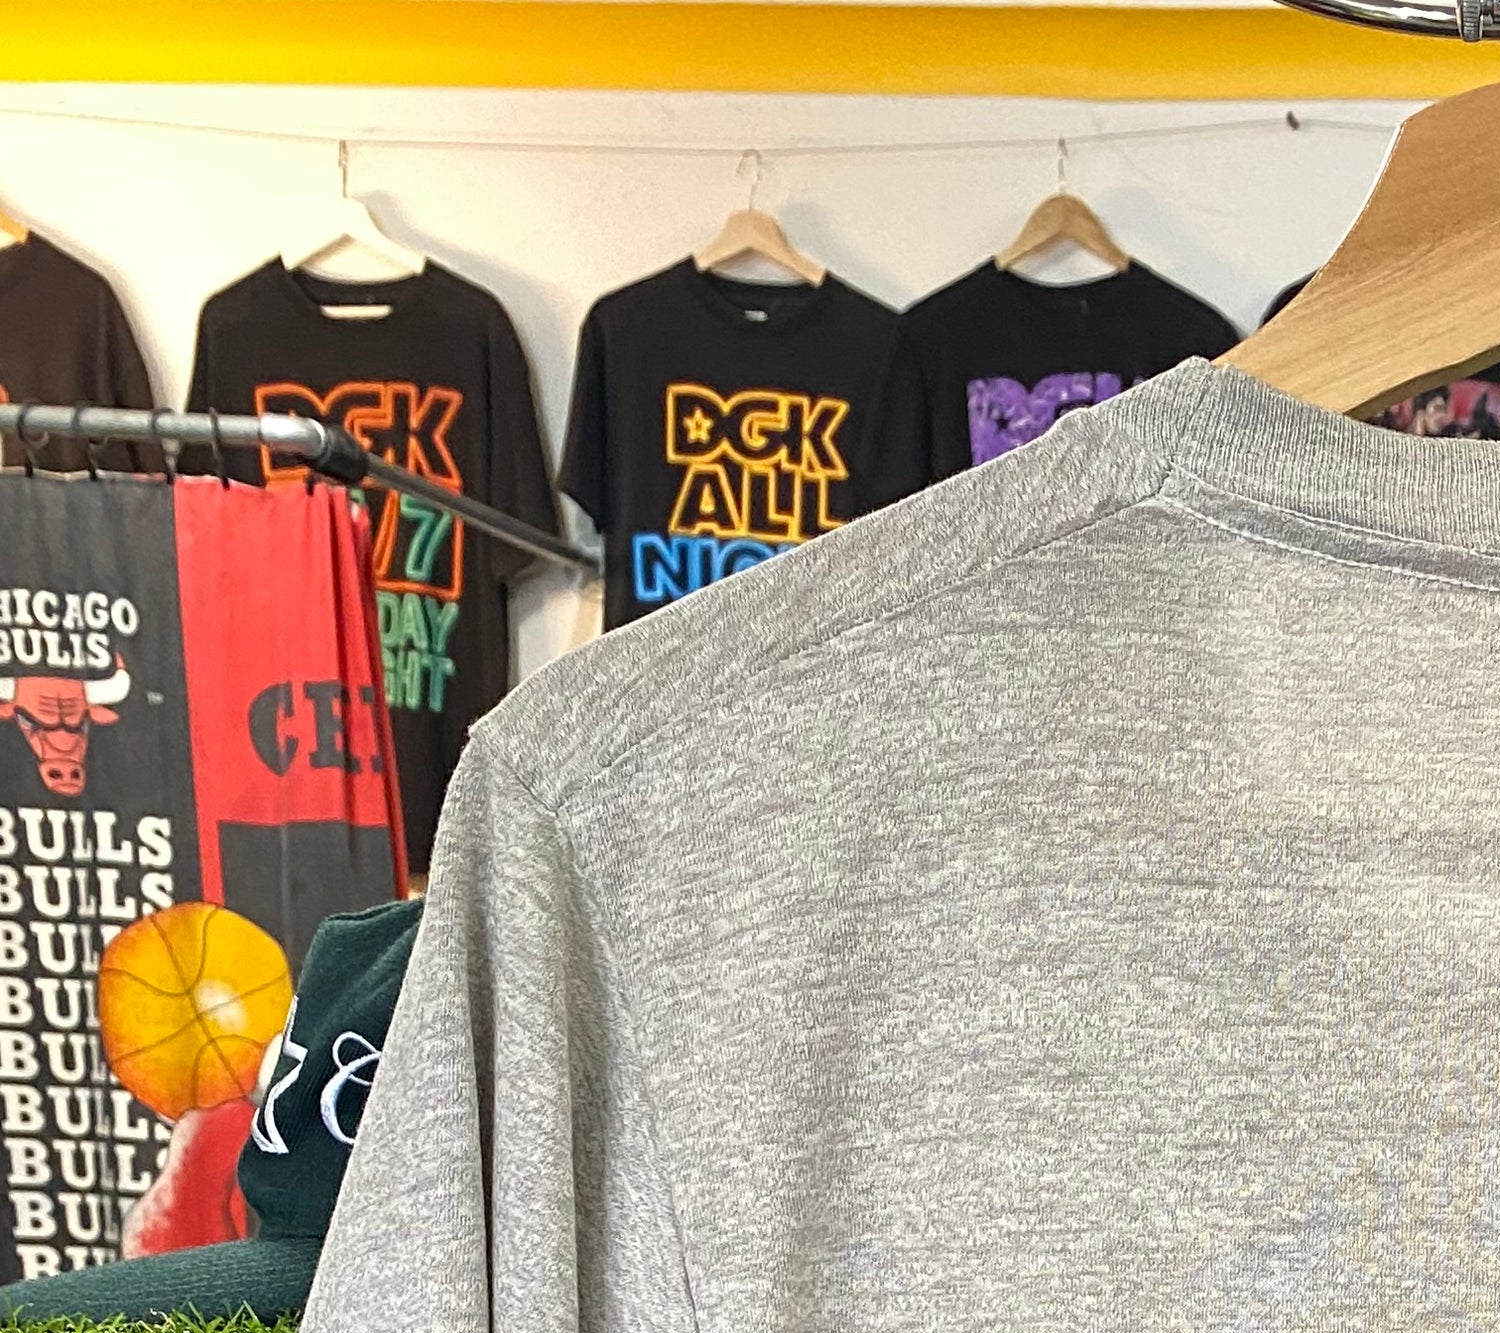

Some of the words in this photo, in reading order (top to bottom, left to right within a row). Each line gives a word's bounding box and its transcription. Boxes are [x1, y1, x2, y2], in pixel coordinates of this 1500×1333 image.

[666, 384, 850, 480] DGK
[669, 462, 850, 543] ALL
[4, 1138, 169, 1192] BULL
